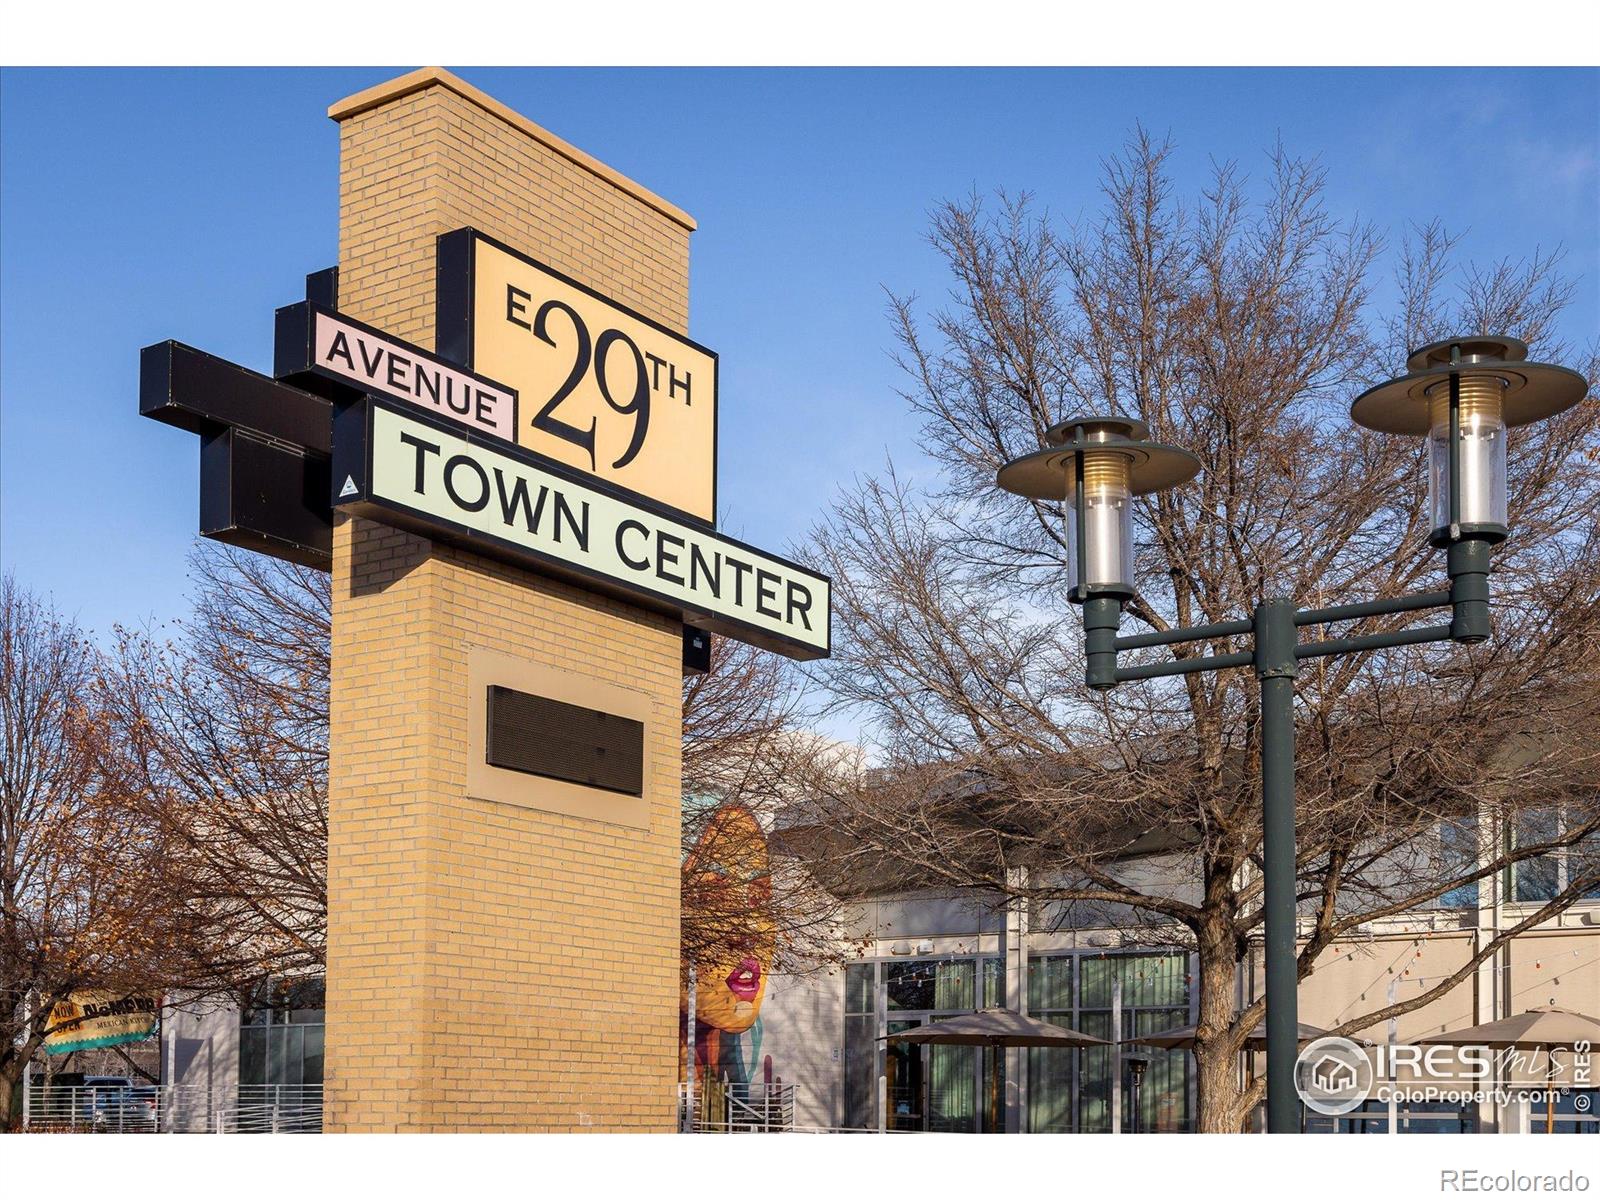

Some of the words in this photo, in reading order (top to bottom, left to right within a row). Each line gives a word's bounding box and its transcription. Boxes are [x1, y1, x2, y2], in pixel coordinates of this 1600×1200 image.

[327, 330, 497, 428] AVENUE
[401, 431, 590, 553] TOWN
[616, 519, 813, 632] CENTER
[55, 1004, 74, 1018] NOW
[97, 1018, 129, 1029] MEXICAN
